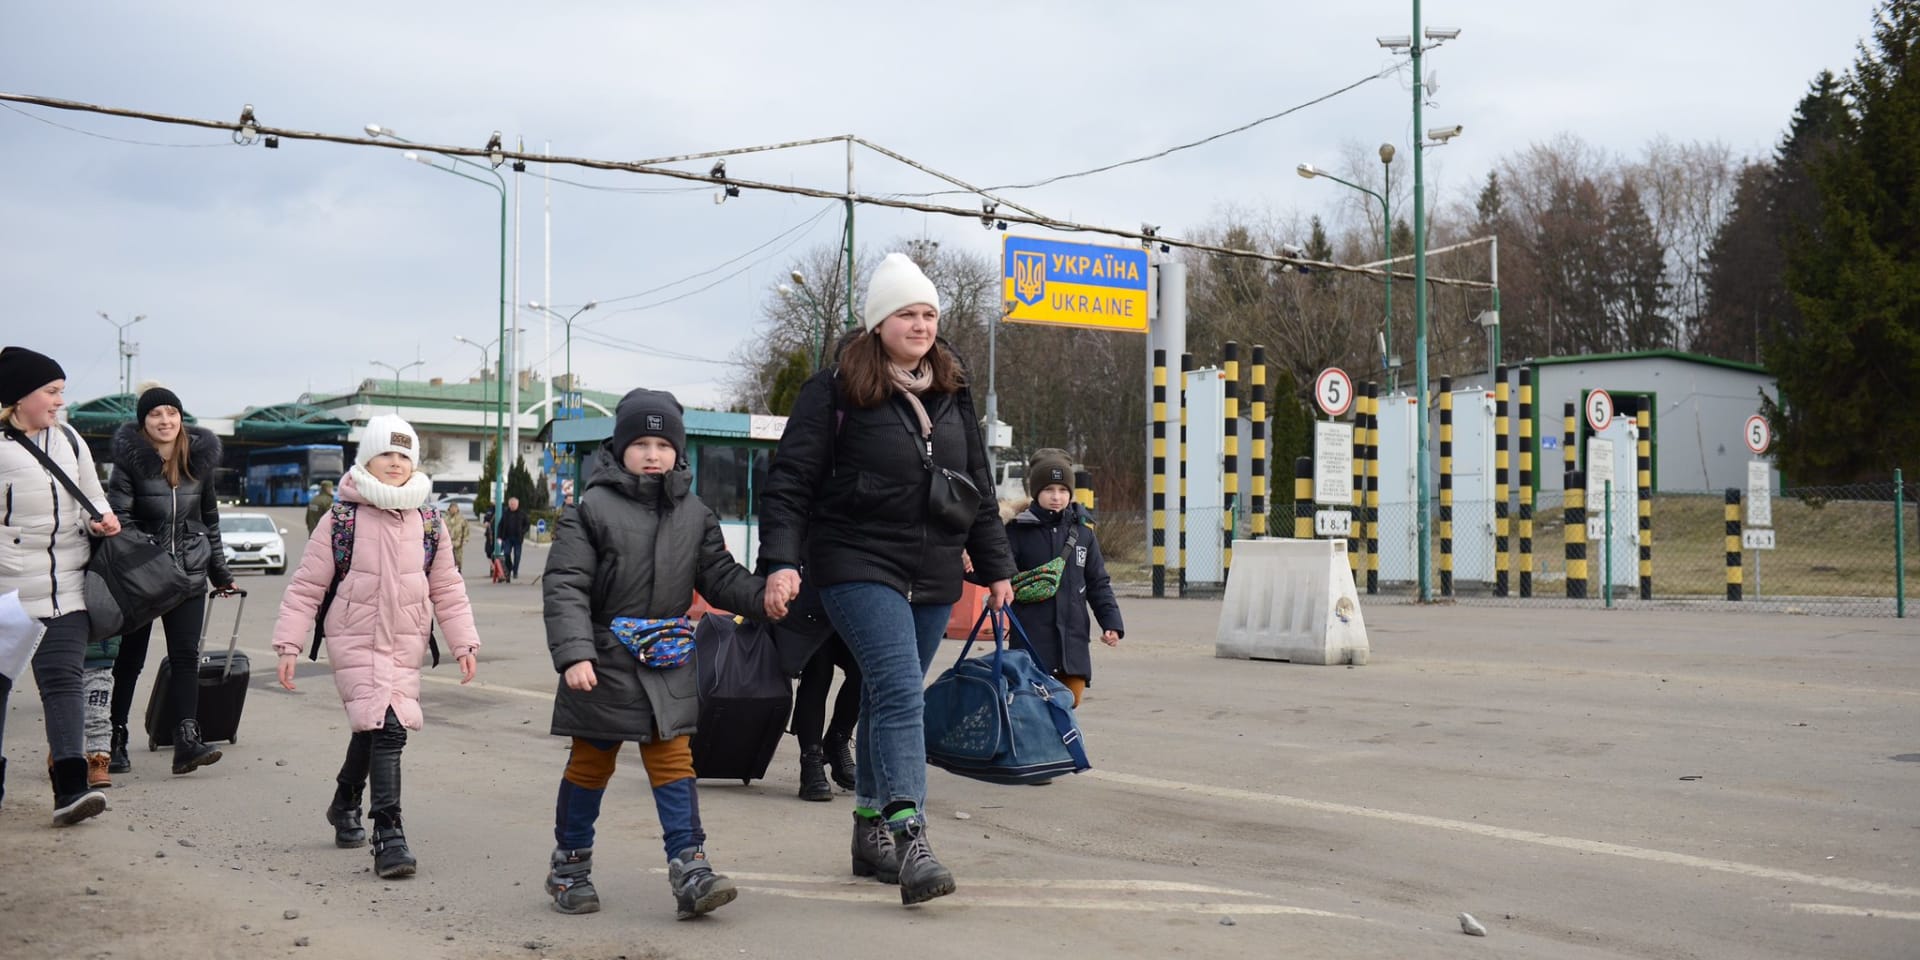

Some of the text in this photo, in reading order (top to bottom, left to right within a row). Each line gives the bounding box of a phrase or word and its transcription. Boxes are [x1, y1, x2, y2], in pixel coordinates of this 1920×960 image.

[1053, 254, 1139, 280] УКРАЇНА
[1052, 293, 1133, 317] UKRAINE
[1328, 380, 1340, 403] 5
[1595, 401, 1604, 423] 5
[1752, 425, 1761, 444] 5
